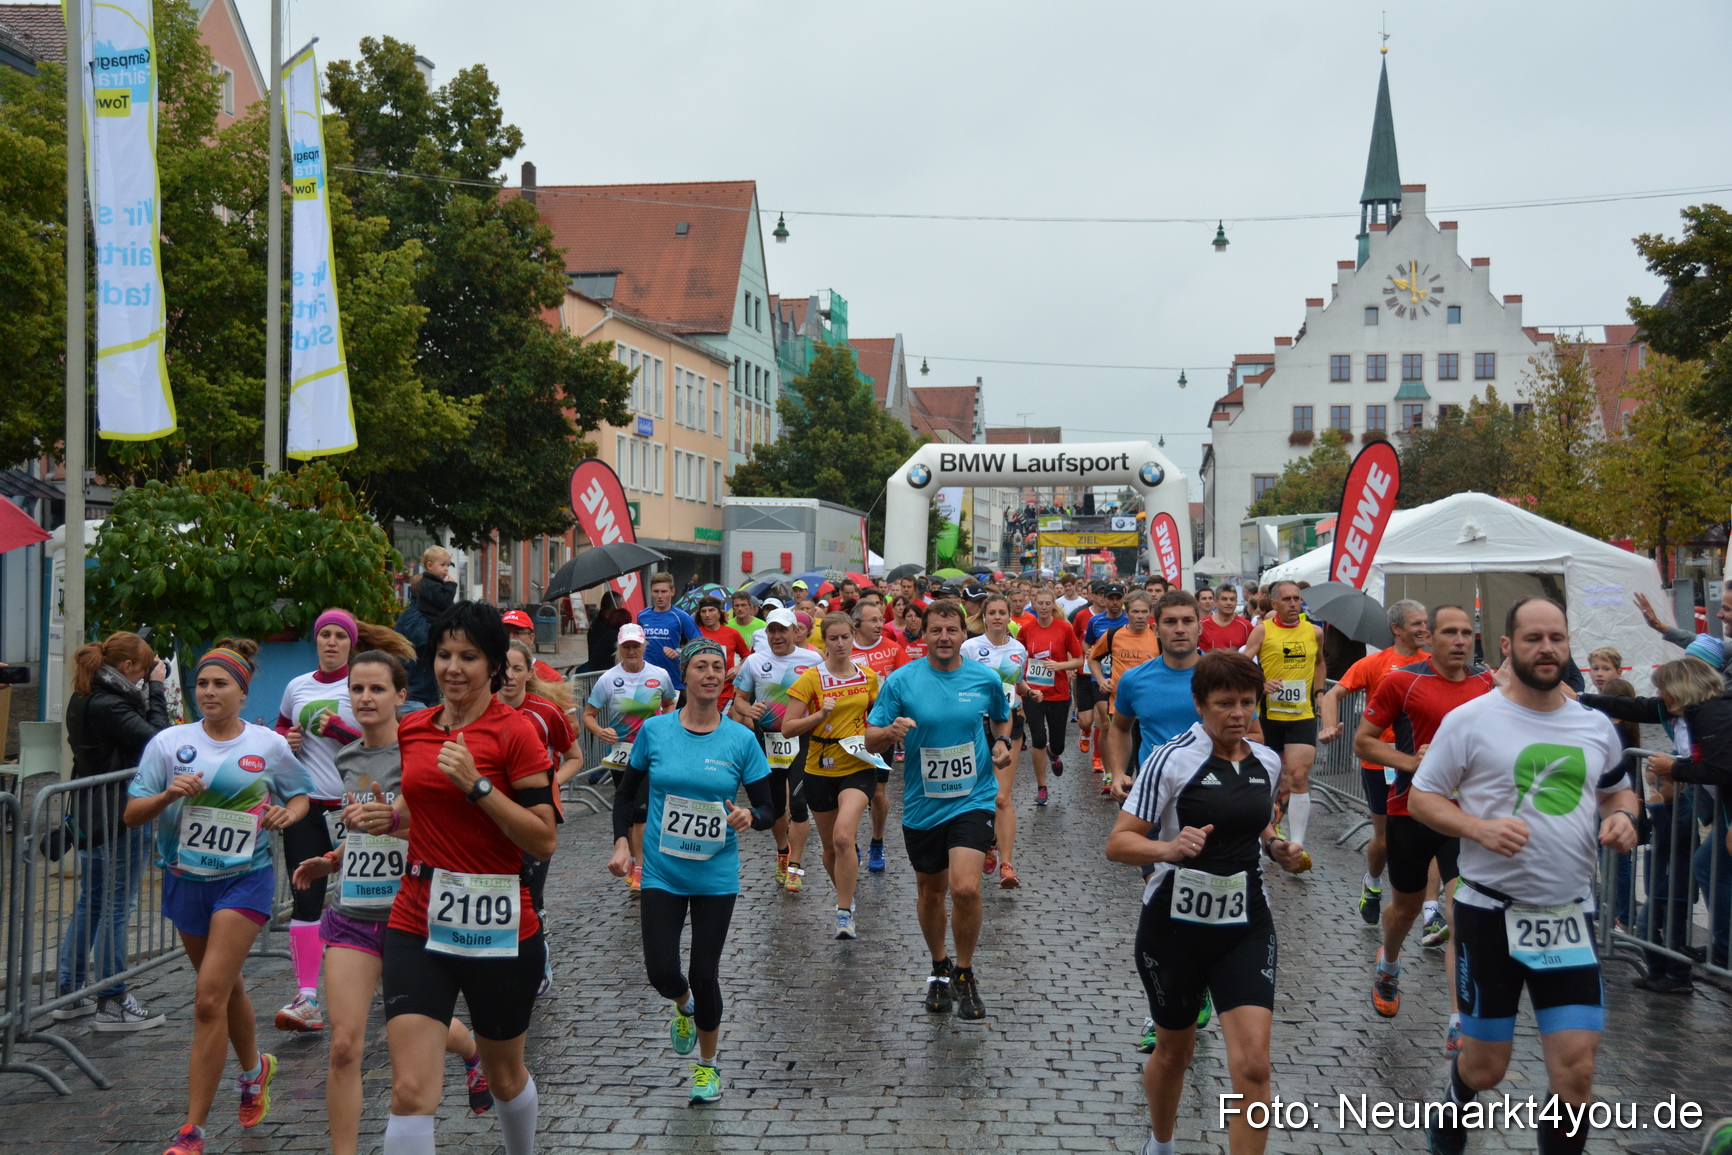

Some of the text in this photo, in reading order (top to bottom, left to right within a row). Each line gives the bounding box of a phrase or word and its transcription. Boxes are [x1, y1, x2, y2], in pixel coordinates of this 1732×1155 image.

[940, 452, 1130, 476] BMW Laufsport
[1335, 462, 1391, 588] REWE
[1077, 535, 1100, 545] ZIEL
[847, 687, 868, 696] BÖGL
[1277, 688, 1300, 701] 209
[612, 750, 630, 765] 22
[174, 765, 195, 773] PARTL
[927, 756, 974, 779] 2795
[941, 780, 963, 792] Claus
[217, 811, 253, 825] BOCK
[667, 810, 721, 838] 2758
[186, 822, 251, 854] 2407
[365, 835, 401, 845] BOCK
[680, 840, 701, 852] Julia
[200, 855, 226, 869] Katja
[347, 850, 404, 878] 2229
[470, 877, 513, 888] BOCK
[1210, 875, 1246, 888] BOCK
[355, 884, 393, 895] Theresa
[437, 891, 513, 926] 2109
[1176, 886, 1244, 919] 3013
[452, 931, 492, 945] Sabine
[1516, 916, 1581, 948] 2570
[1541, 953, 1562, 966] Jan
